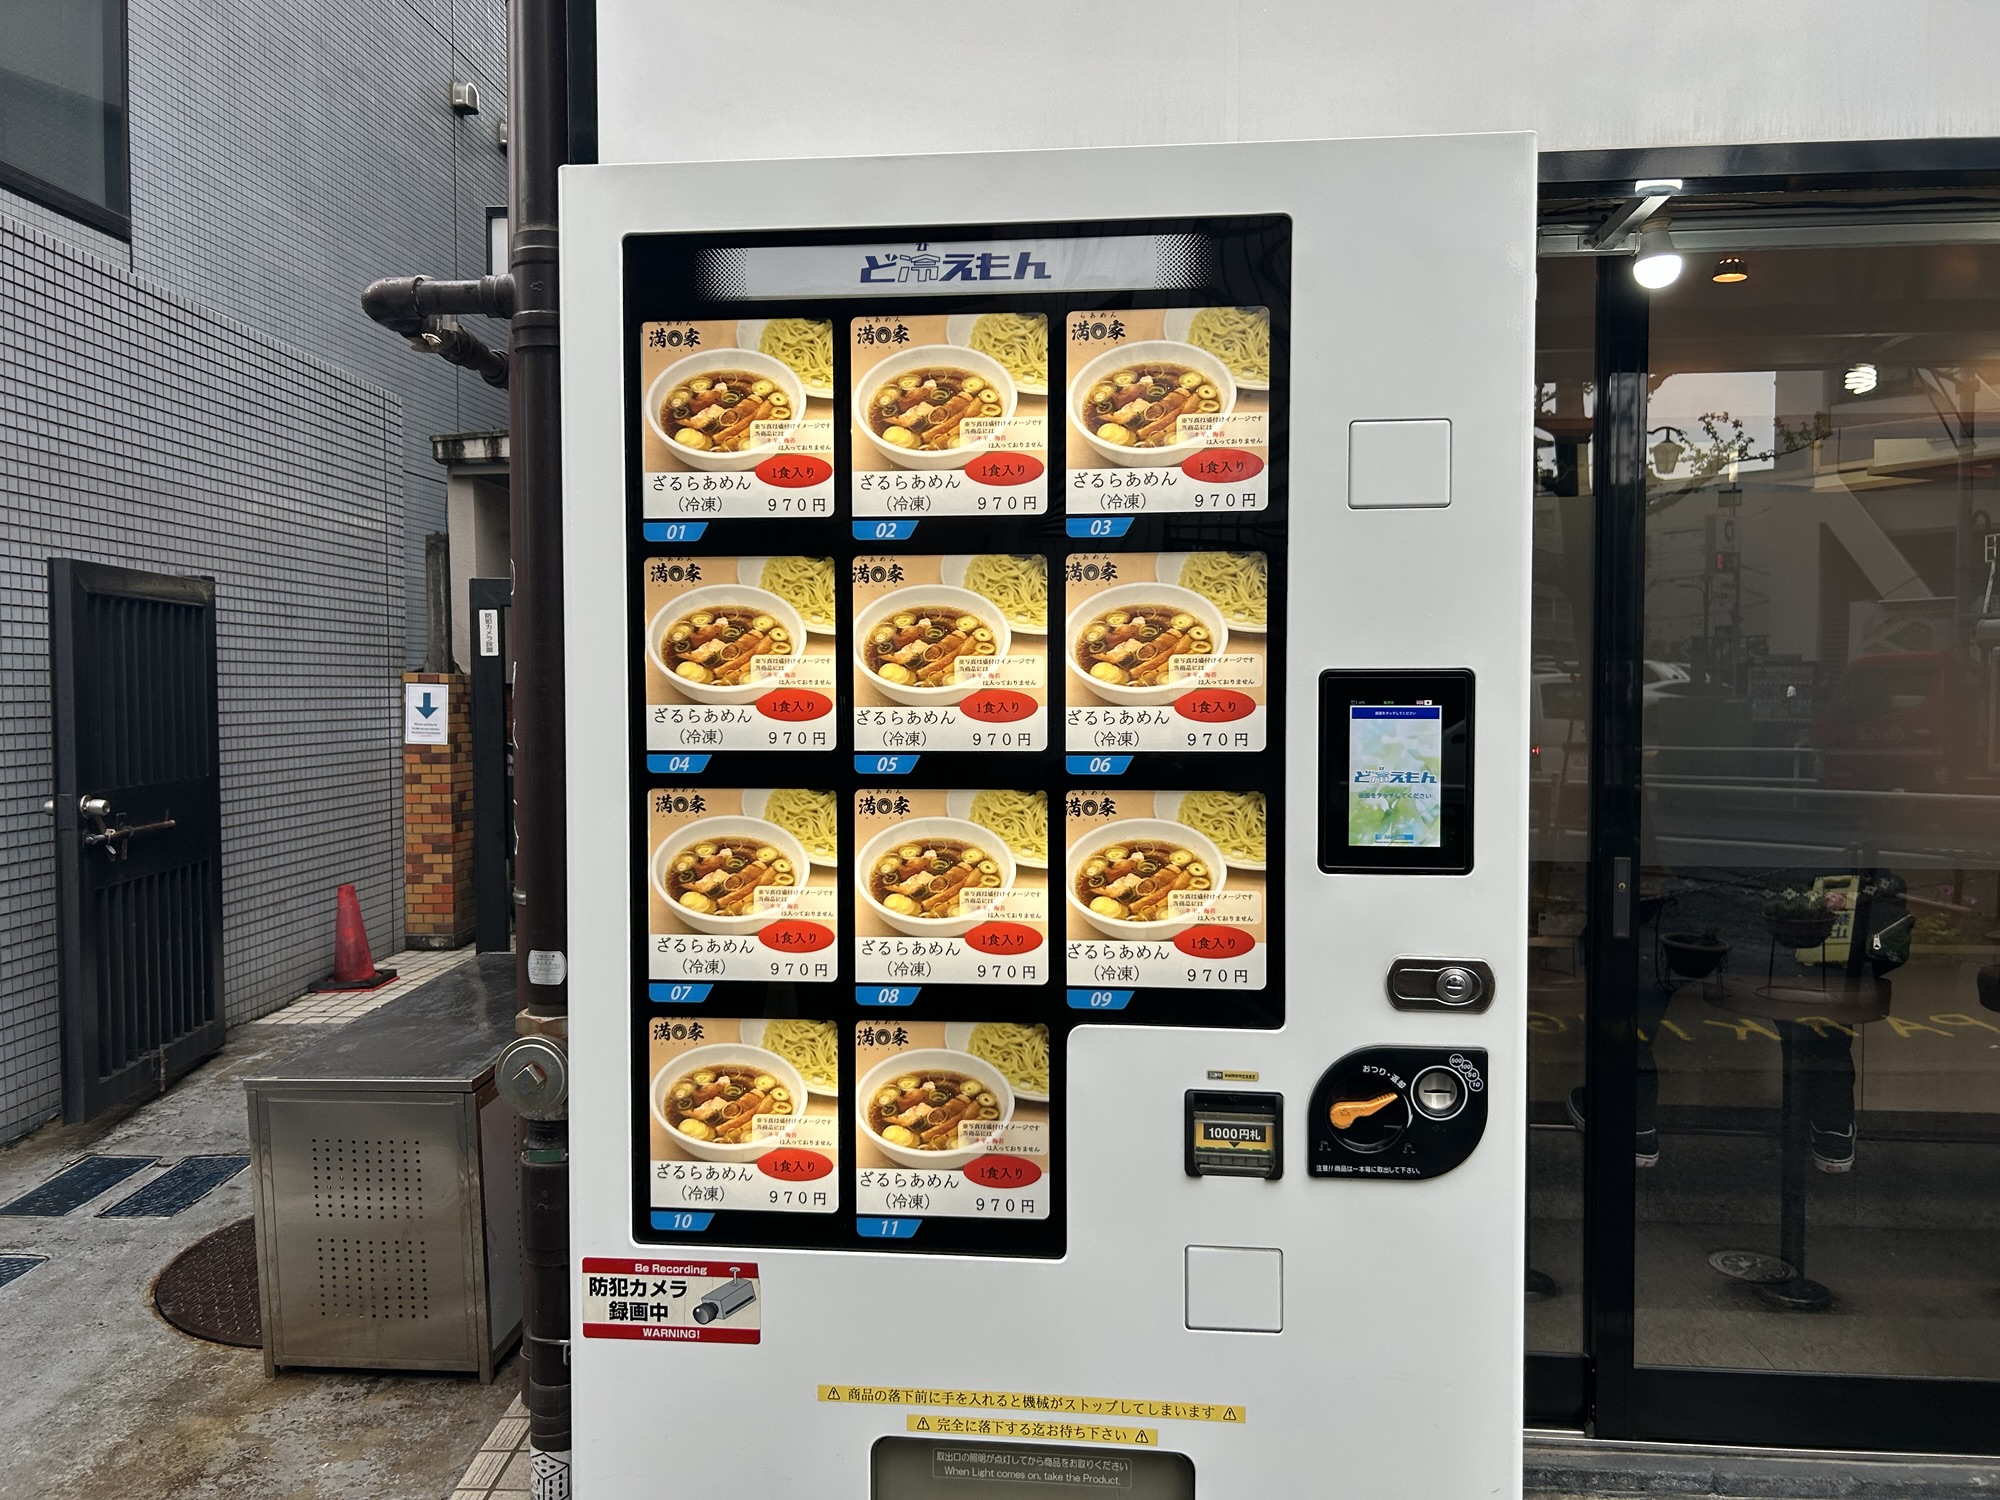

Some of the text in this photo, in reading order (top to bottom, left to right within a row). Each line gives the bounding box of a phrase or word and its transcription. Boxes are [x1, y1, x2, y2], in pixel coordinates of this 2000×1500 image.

[860, 252, 1051, 283] ど冷えもん
[772, 466, 814, 480] 1食入り
[982, 464, 1025, 478] 1食入り
[1200, 461, 1244, 475] 1食入り
[653, 476, 752, 491] ざるらあめん
[861, 474, 961, 490] ざるらあめん
[1074, 471, 1178, 488] ざるらあめん
[678, 496, 722, 513] （冷凍）
[768, 498, 826, 511] 970円
[886, 495, 931, 512] （冷凍）
[978, 496, 1037, 510] 970円
[1100, 492, 1146, 510] （冷凍）
[1195, 493, 1256, 508] 970円
[666, 525, 686, 539] 01
[876, 523, 896, 538] 02
[1090, 520, 1110, 535] 03
[773, 701, 815, 713] 1食入り
[977, 701, 1019, 715] 1食入り
[1192, 701, 1236, 714] 1食入り
[654, 708, 753, 723] ざるらあめん
[857, 710, 956, 725] ざるらあめん
[1068, 710, 1170, 725] ざるらあめん
[679, 728, 723, 745] （冷凍）
[769, 731, 826, 745] 970円
[882, 730, 927, 747] （冷凍）
[973, 733, 1031, 746] 970円
[1093, 730, 1139, 747] （冷凍）
[1187, 733, 1248, 746] 970円
[669, 757, 689, 771] 04
[876, 757, 898, 772] 05
[1090, 758, 1111, 772] 06
[658, 937, 755, 954] ざるらあめん
[775, 932, 817, 944] 1食入り
[982, 934, 1024, 946] 1食入り
[1192, 937, 1236, 950] 1食入り
[862, 940, 961, 956] ざるらあめん
[1068, 944, 1170, 960] ざるらあめん
[682, 958, 726, 975] （冷凍）
[771, 962, 828, 976] 970円
[887, 961, 931, 977] （冷凍）
[978, 964, 1036, 979] 970円
[1093, 964, 1140, 981] （冷凍）
[1187, 968, 1248, 983] 970円
[670, 986, 692, 1000] 07
[878, 989, 900, 1003] 08
[1091, 992, 1112, 1006] 09
[1209, 1127, 1261, 1141] 1000円札
[657, 1164, 753, 1182] ざるらあめん
[774, 1161, 815, 1173] 1食入り
[980, 1167, 1023, 1180] 1食入り
[860, 1171, 960, 1189] ざるらあめん
[681, 1184, 725, 1202] （冷凍）
[770, 1190, 827, 1205] 970円
[885, 1192, 930, 1210] （冷凍）
[976, 1197, 1035, 1213] 970円
[674, 1214, 692, 1228] 10
[881, 1221, 899, 1235] 11
[635, 1264, 707, 1275] Be Recording
[589, 1277, 687, 1298] 防犯カメラ
[609, 1301, 668, 1322] 録画中
[643, 1328, 700, 1338] WARNING!
[848, 1388, 1215, 1418] 商品の落下前に手を入れると機械がストップしてしまいます
[937, 1418, 1126, 1440] 完全に落下する迄お待ち下さい
[944, 1466, 969, 1476] When
[972, 1468, 994, 1478] Light
[998, 1471, 1025, 1479] comes
[1044, 1472, 1063, 1481] take
[1066, 1473, 1080, 1482] the
[1082, 1474, 1120, 1485] Product.
